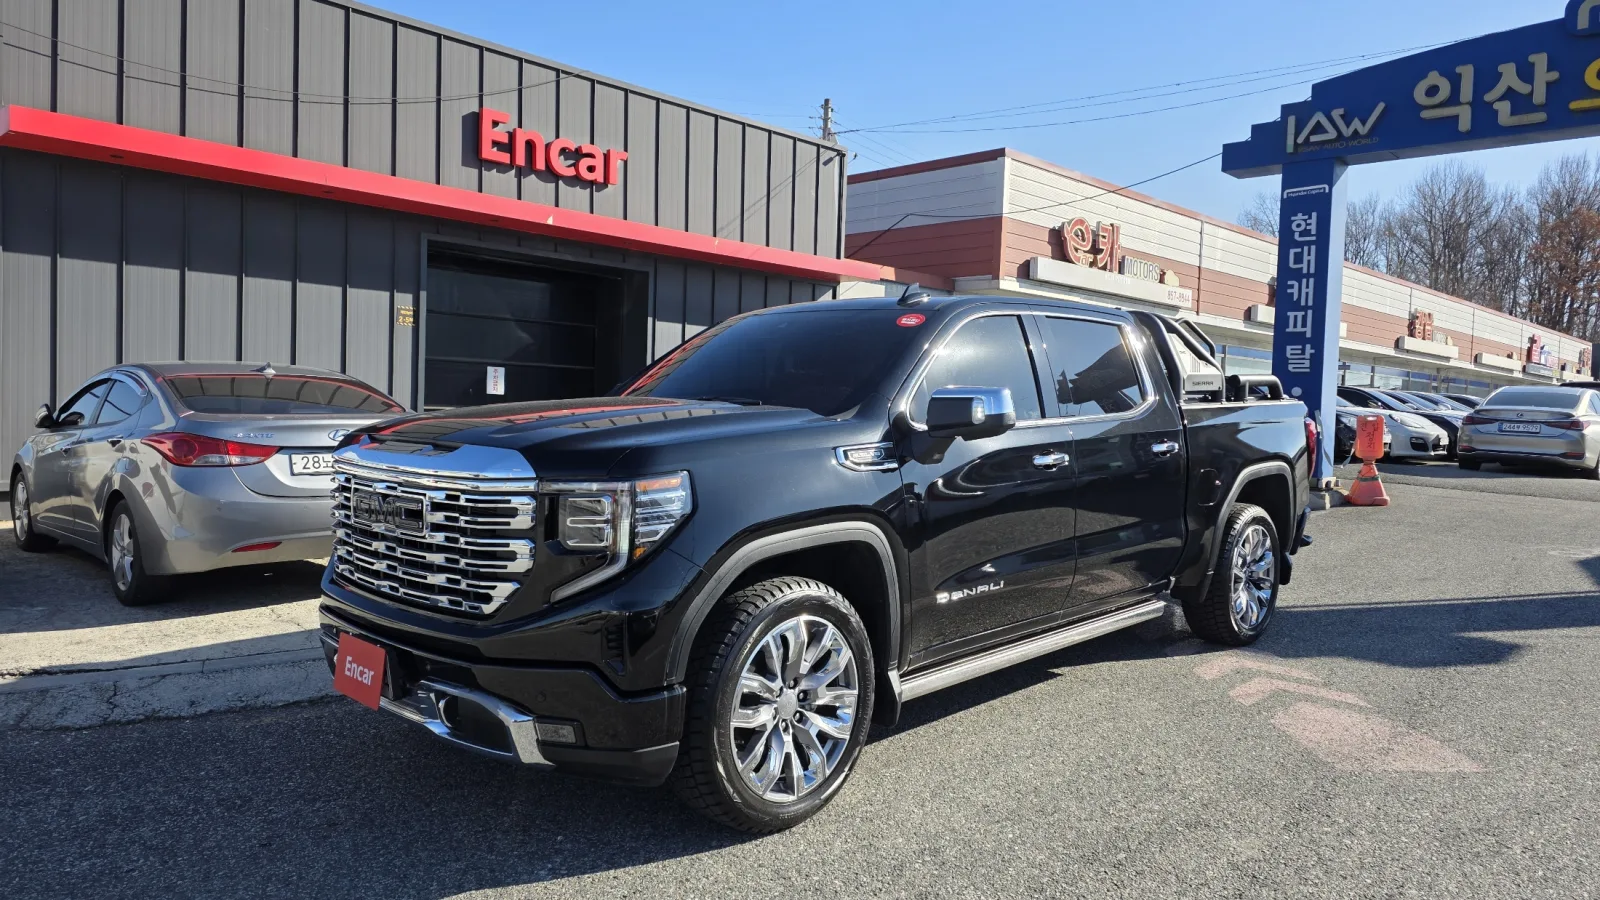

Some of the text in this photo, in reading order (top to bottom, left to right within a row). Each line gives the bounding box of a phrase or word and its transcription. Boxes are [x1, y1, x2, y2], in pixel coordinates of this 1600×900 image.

[1413, 52, 1560, 133] 익산
[478, 107, 629, 186] Encar
[1323, 140, 1346, 150] AUTO
[1348, 136, 1379, 147] WORLD
[1126, 257, 1160, 282] MOTORS
[1285, 212, 1318, 373] 현대캐피탈
[354, 493, 423, 532] GMC
[936, 580, 1005, 604] DENALI
[344, 655, 375, 686] Encar
